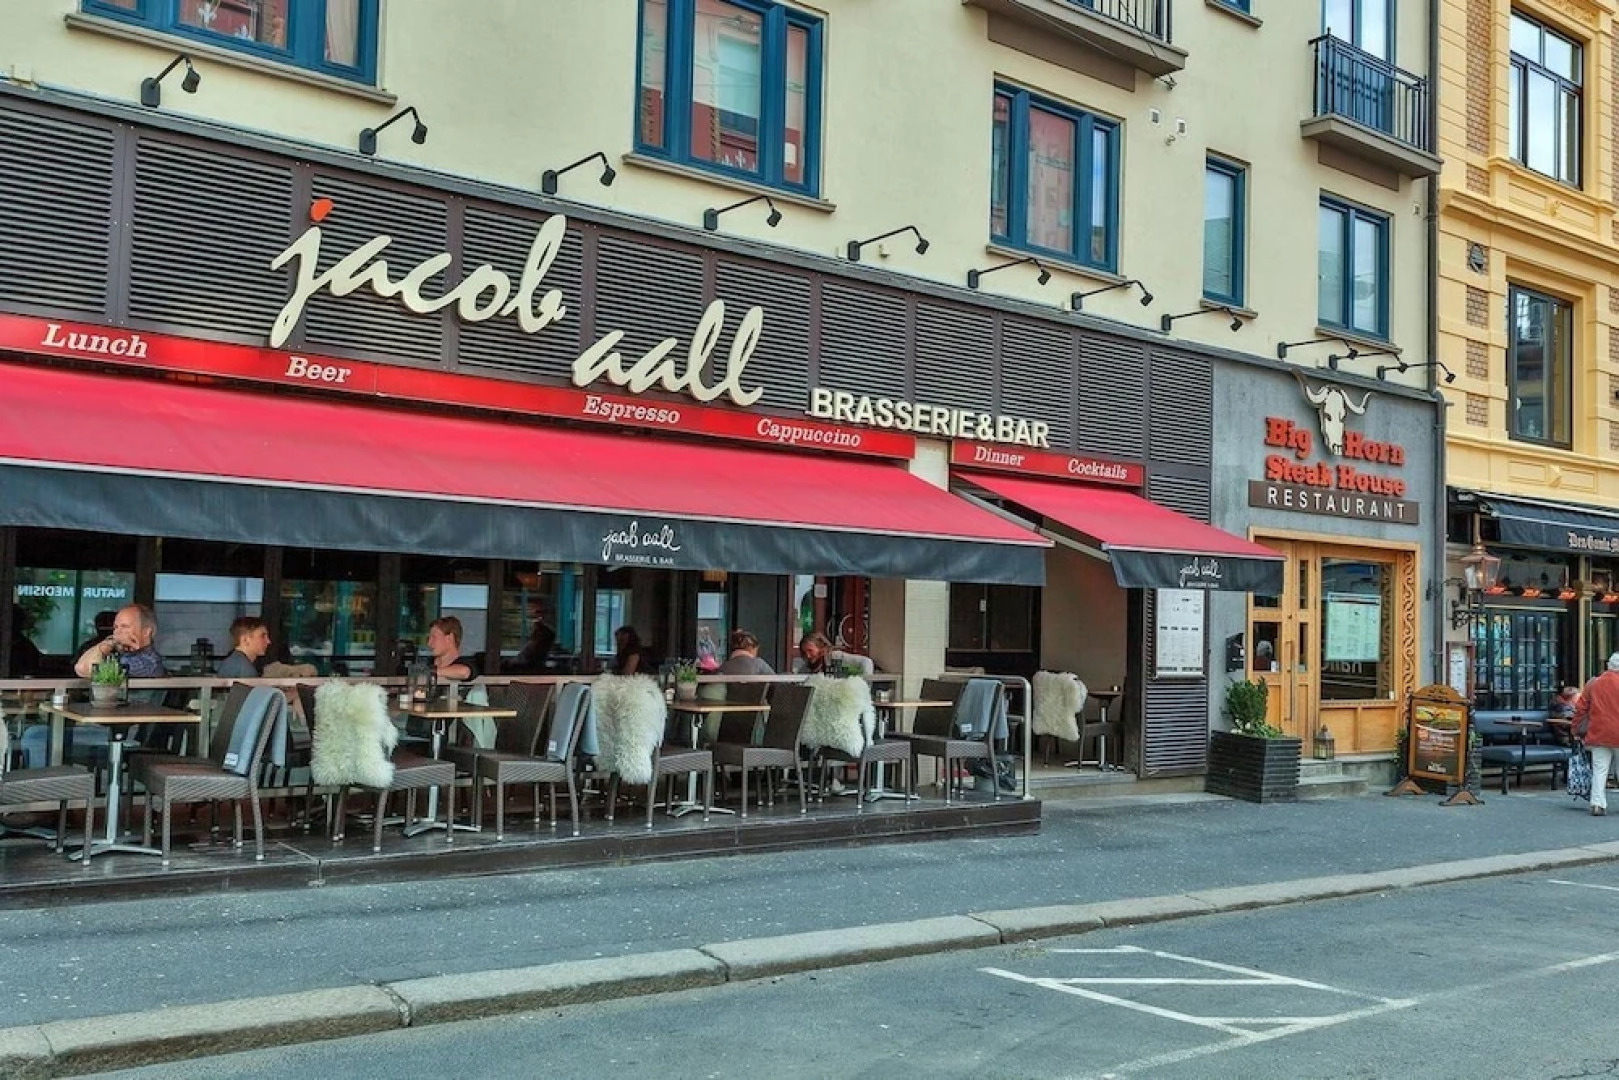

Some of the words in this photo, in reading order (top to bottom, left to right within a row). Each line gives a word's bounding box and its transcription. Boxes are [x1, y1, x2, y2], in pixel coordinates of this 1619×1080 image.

[270, 197, 566, 348] jacob
[41, 323, 148, 358] Lunch
[572, 299, 763, 406] aall
[284, 355, 351, 383] Beer
[582, 394, 681, 424] Espresso
[756, 418, 861, 447] Cappuccino
[1265, 417, 1312, 459] Big
[1343, 430, 1405, 466] Horn
[974, 445, 1025, 467] Dinner
[1067, 458, 1128, 480] Cocktails
[1265, 454, 1332, 487] Steak
[1336, 464, 1406, 496] House
[1266, 486, 1405, 519] RESTAURANT
